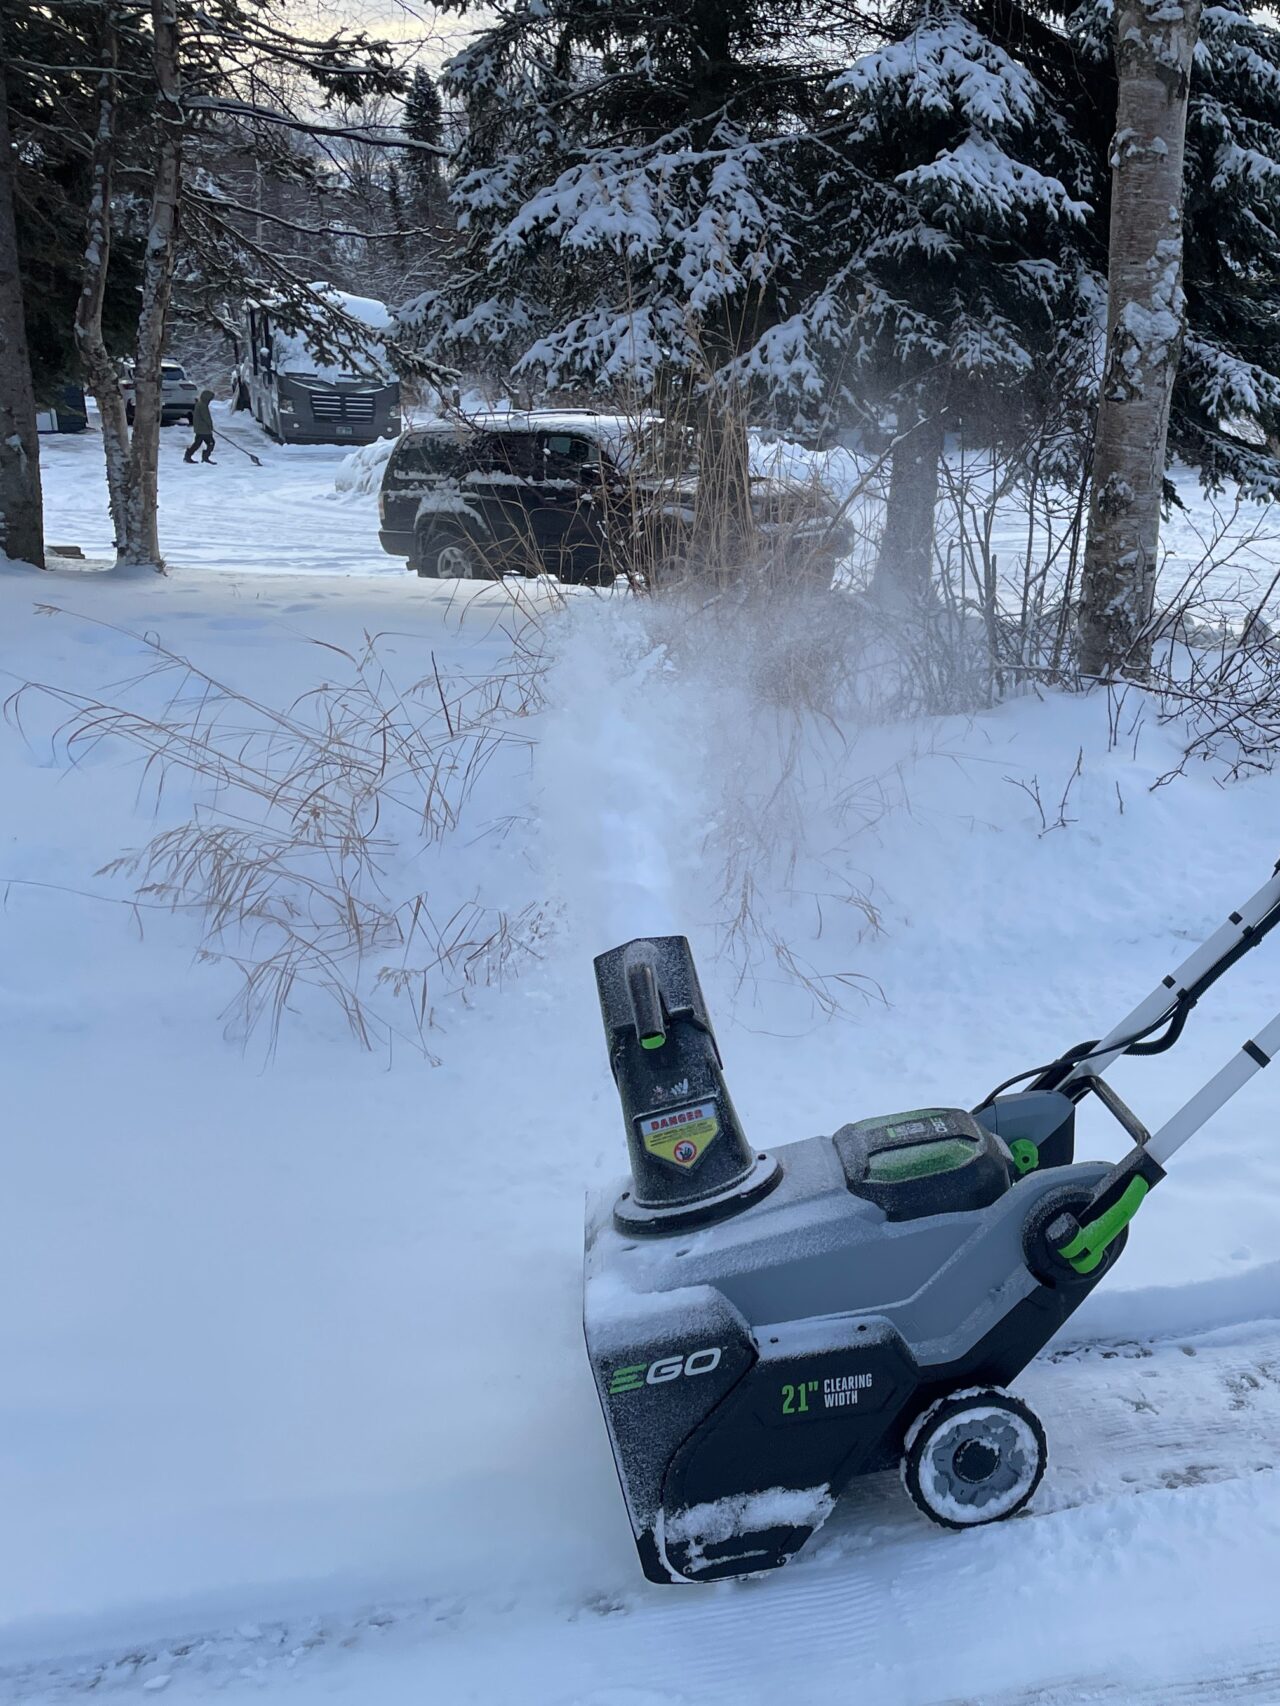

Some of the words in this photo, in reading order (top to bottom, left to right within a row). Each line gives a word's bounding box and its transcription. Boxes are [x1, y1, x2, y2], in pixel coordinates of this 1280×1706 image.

[650, 1109, 704, 1131] DANGER
[609, 1347, 722, 1395] EGO
[823, 1373, 873, 1393] CLEARING
[781, 1381, 819, 1415] 21"
[824, 1390, 858, 1408] WIDTH
